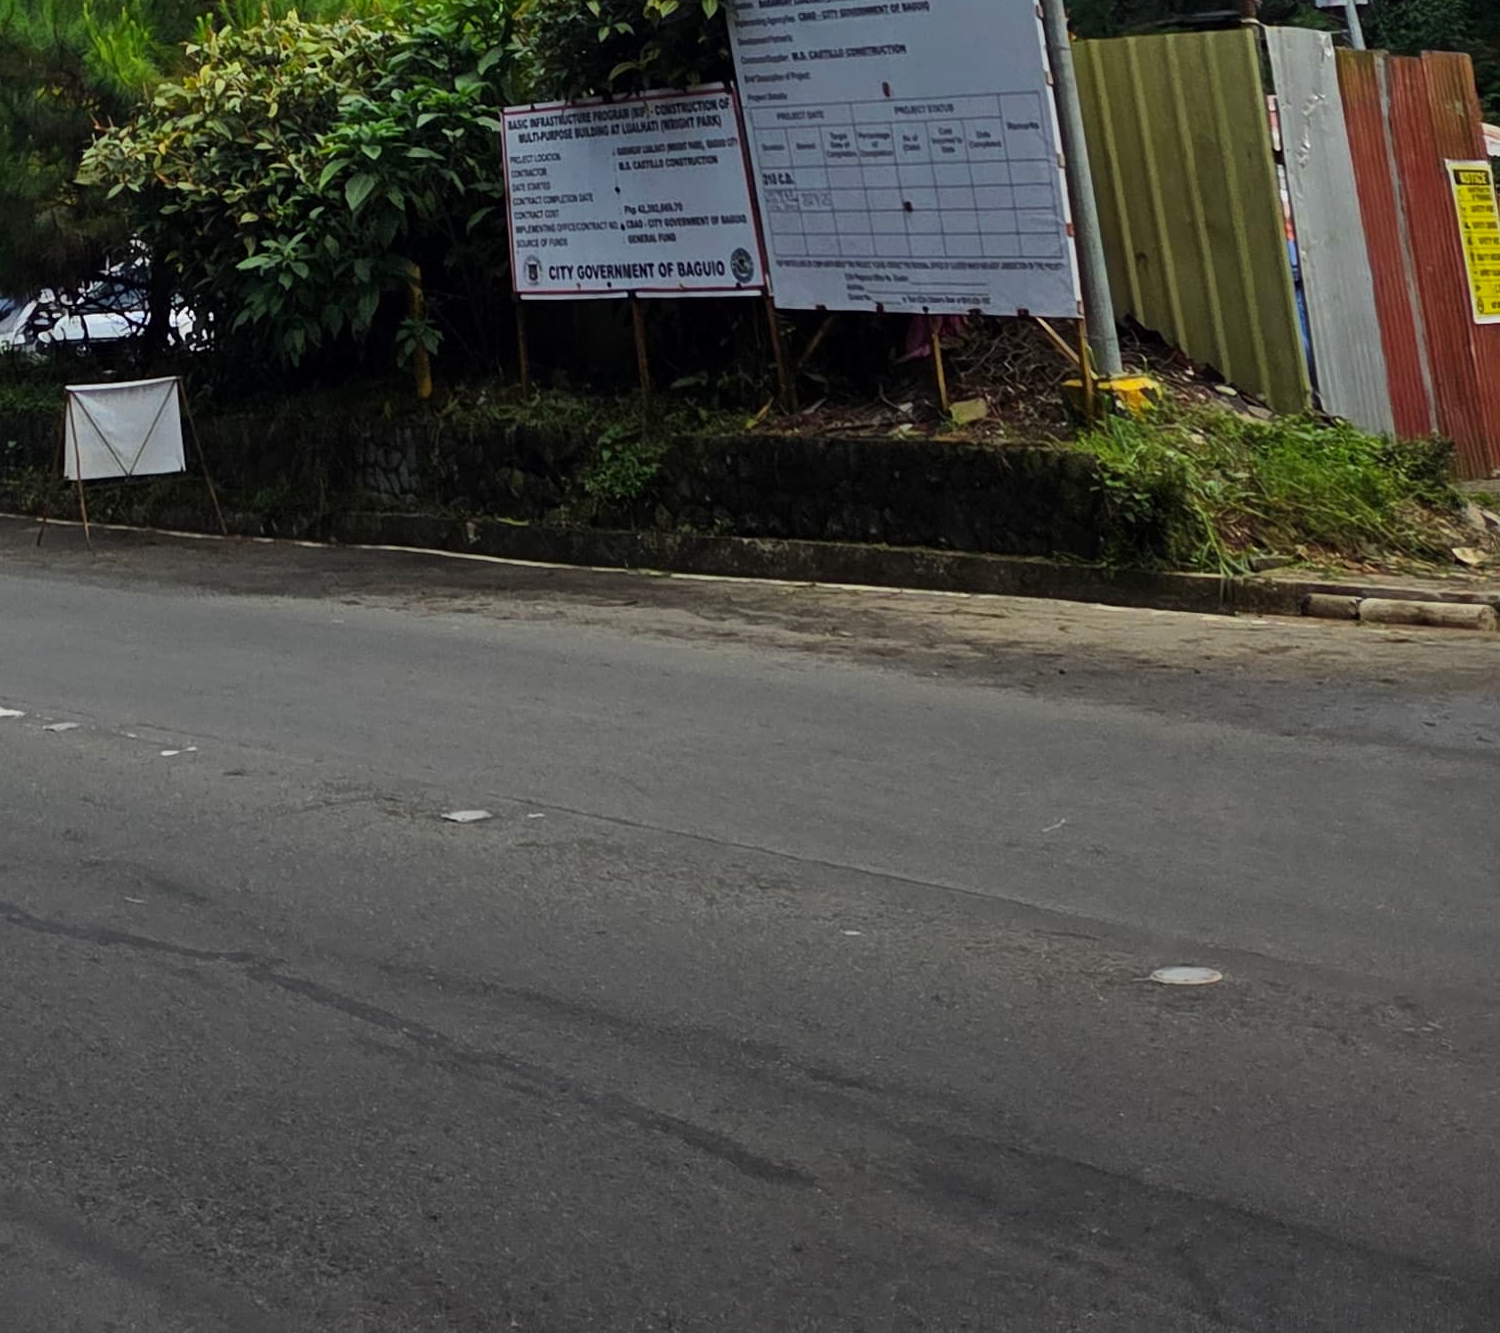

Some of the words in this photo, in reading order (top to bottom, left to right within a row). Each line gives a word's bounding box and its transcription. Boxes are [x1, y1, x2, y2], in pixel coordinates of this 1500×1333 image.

[508, 119, 528, 131] BASIC
[530, 112, 591, 127] INFRASTRUCTURE
[593, 108, 629, 121] PROGRAM
[655, 99, 717, 116] CONSTRUCTION
[718, 98, 730, 109] OF
[518, 129, 573, 143] MULTI-PURPOSE
[574, 125, 609, 138] BUILDING
[611, 124, 620, 135] AT
[548, 264, 574, 280] CITY
[576, 262, 655, 280] GOVERNMENT
[658, 261, 674, 277] OF
[677, 260, 725, 277] BAGUIO
